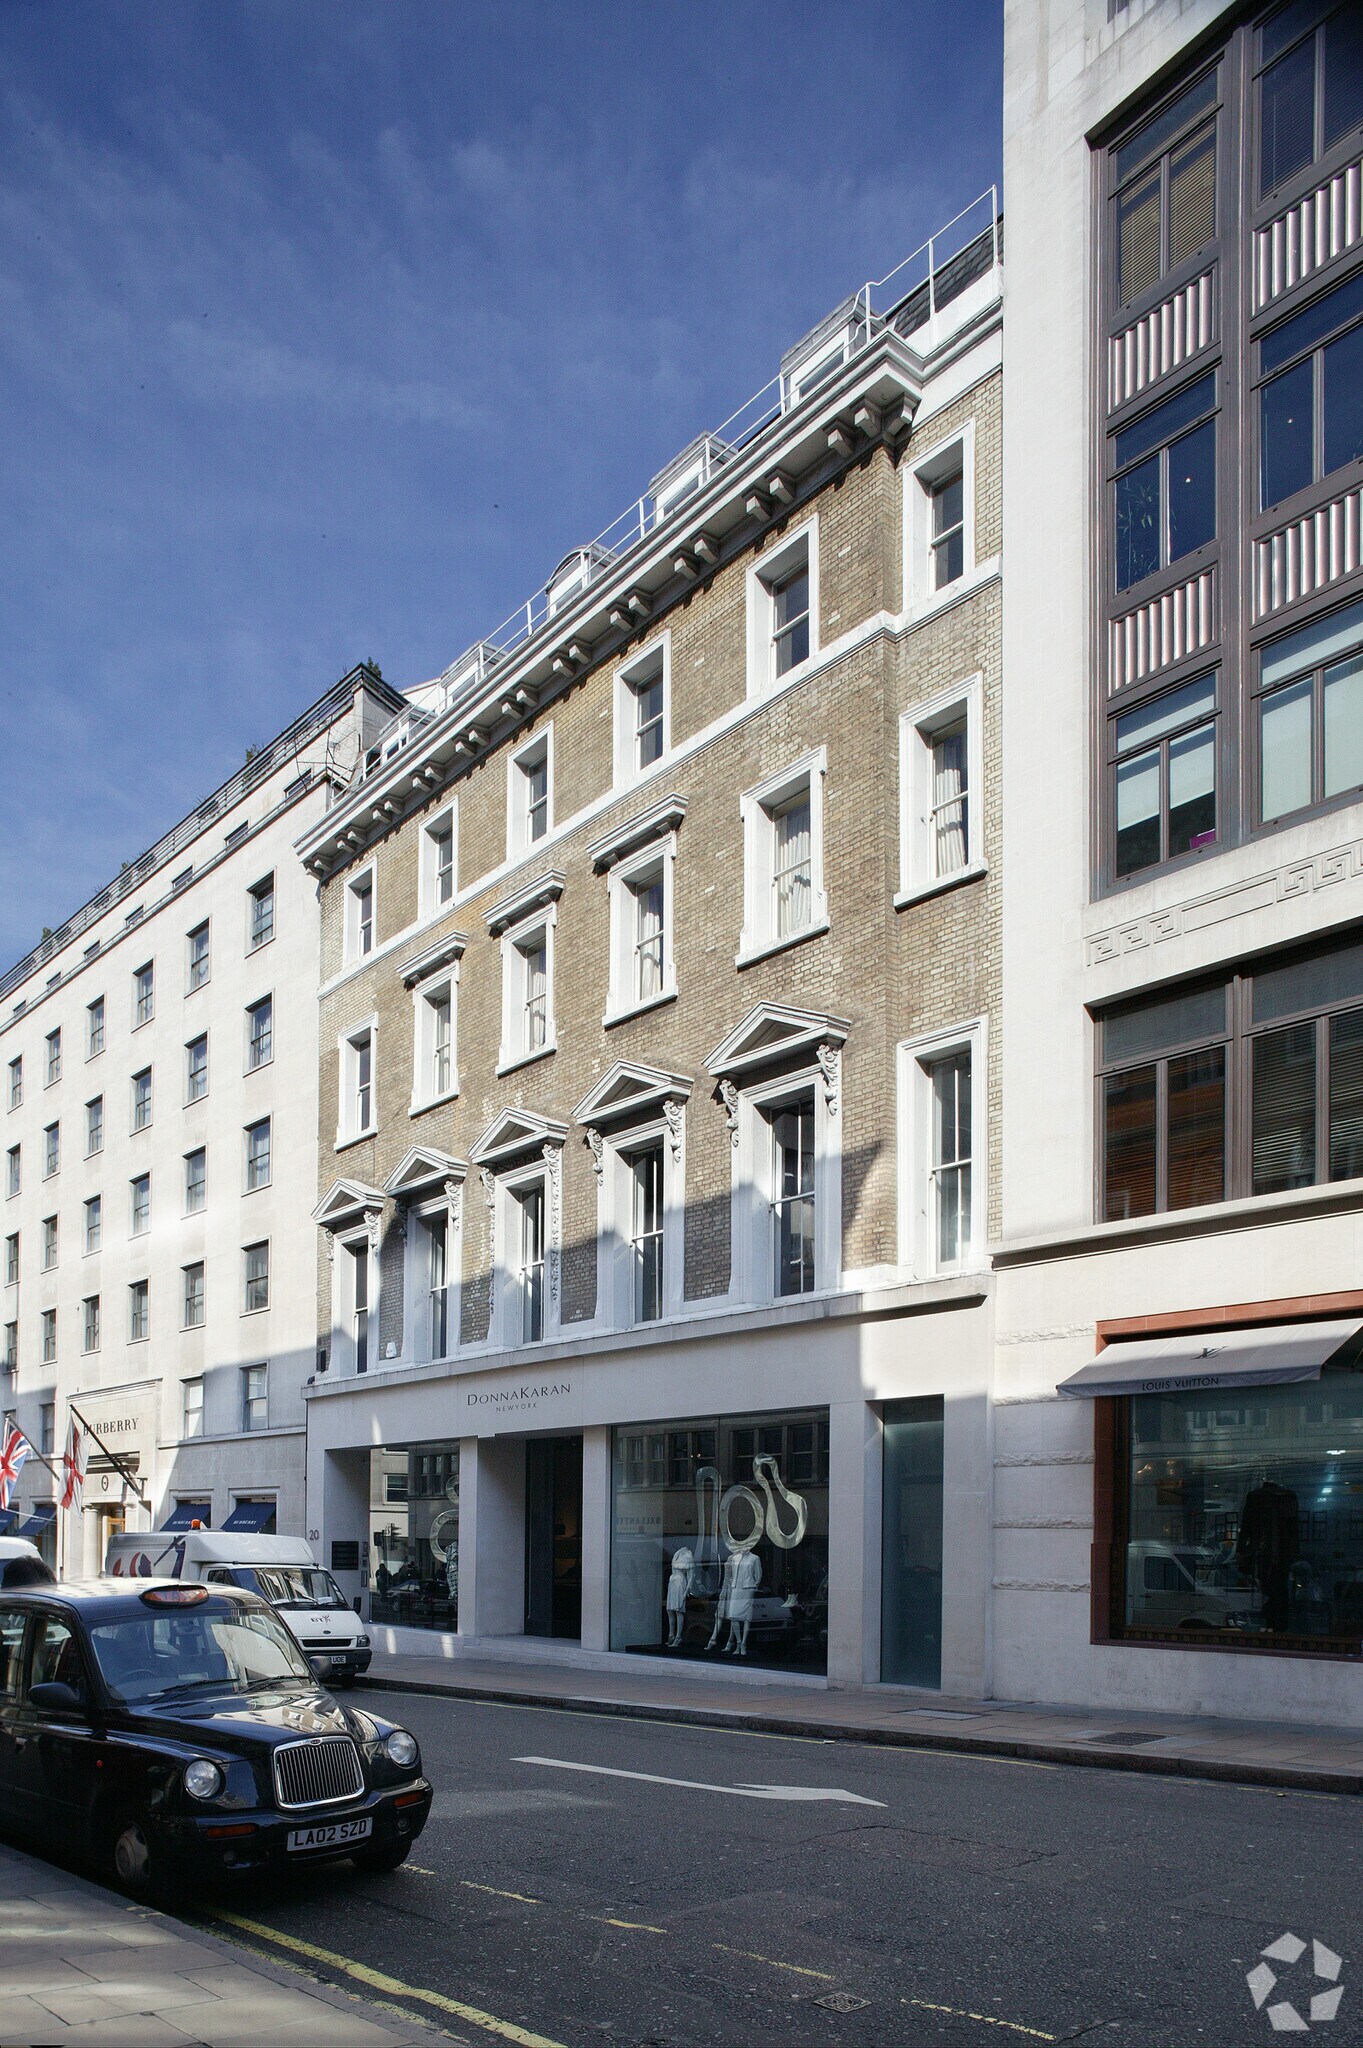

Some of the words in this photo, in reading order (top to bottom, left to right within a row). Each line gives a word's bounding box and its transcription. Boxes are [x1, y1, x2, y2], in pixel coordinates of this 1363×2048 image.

[1142, 1380, 1170, 1391] LOUIS
[1175, 1377, 1219, 1388] VUITTON
[309, 1529, 320, 1541] 20
[294, 1827, 336, 1846] LA02
[341, 1820, 367, 1839] SZD
